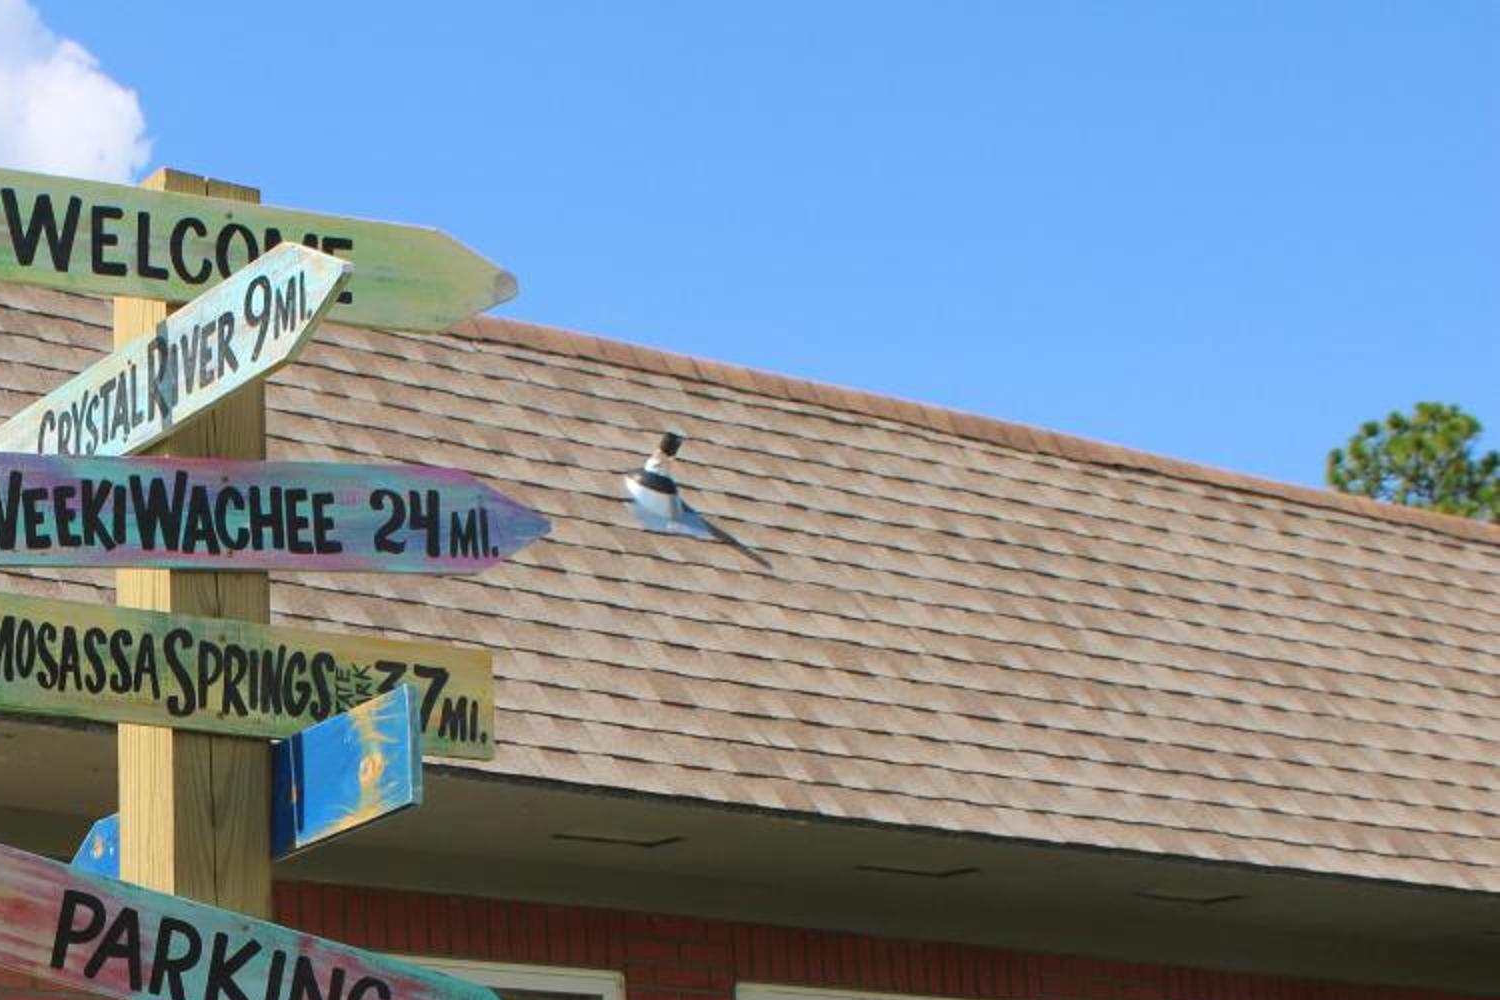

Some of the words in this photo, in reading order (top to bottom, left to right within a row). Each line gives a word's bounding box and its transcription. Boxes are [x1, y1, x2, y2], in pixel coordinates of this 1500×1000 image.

[0, 187, 354, 304] WELCO
[37, 363, 144, 456] CRYSTAL
[147, 311, 239, 422] RIVER
[369, 489, 440, 558] 24
[449, 507, 498, 560] MI.
[163, 628, 336, 722] SPRINGS
[438, 695, 487, 744] MI.
